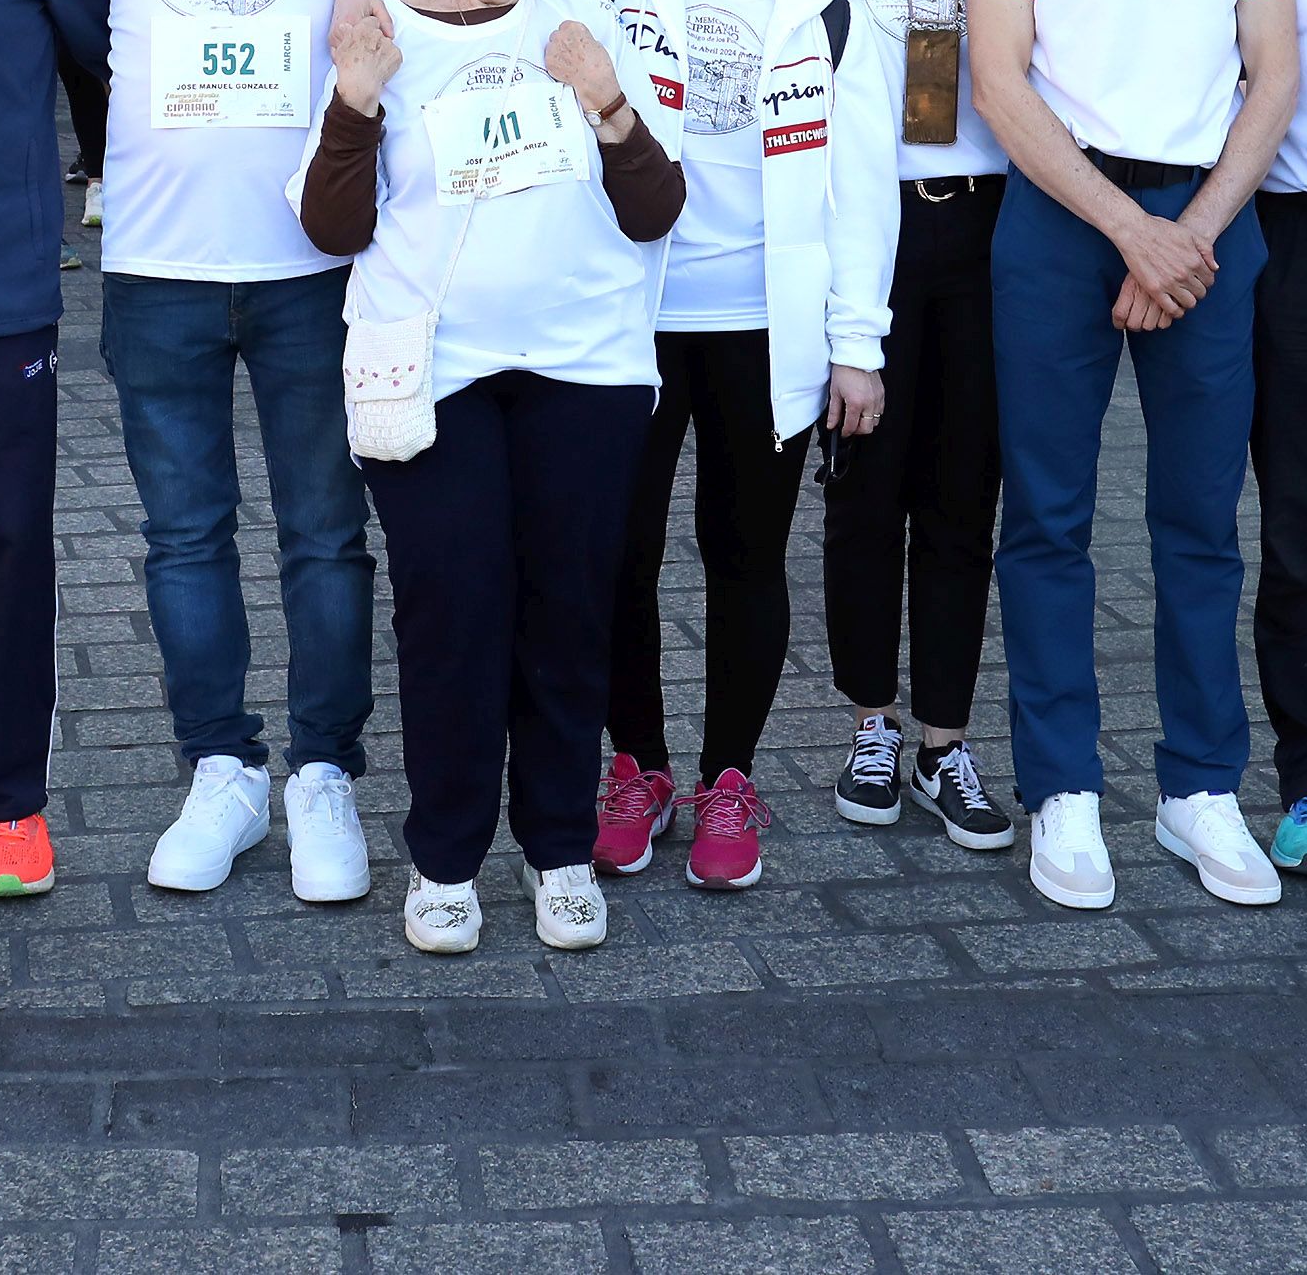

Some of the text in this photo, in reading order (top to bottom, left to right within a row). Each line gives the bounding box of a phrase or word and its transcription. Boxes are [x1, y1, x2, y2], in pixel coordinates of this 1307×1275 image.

[202, 43, 256, 76] 552
[283, 32, 292, 72] MARCHA
[698, 45, 719, 55] Abril
[719, 48, 737, 56] 2024
[176, 83, 197, 91] JOSE
[548, 96, 562, 129] MARCHA
[495, 149, 520, 163] PUÑAL
[523, 141, 548, 151] ARIZA
